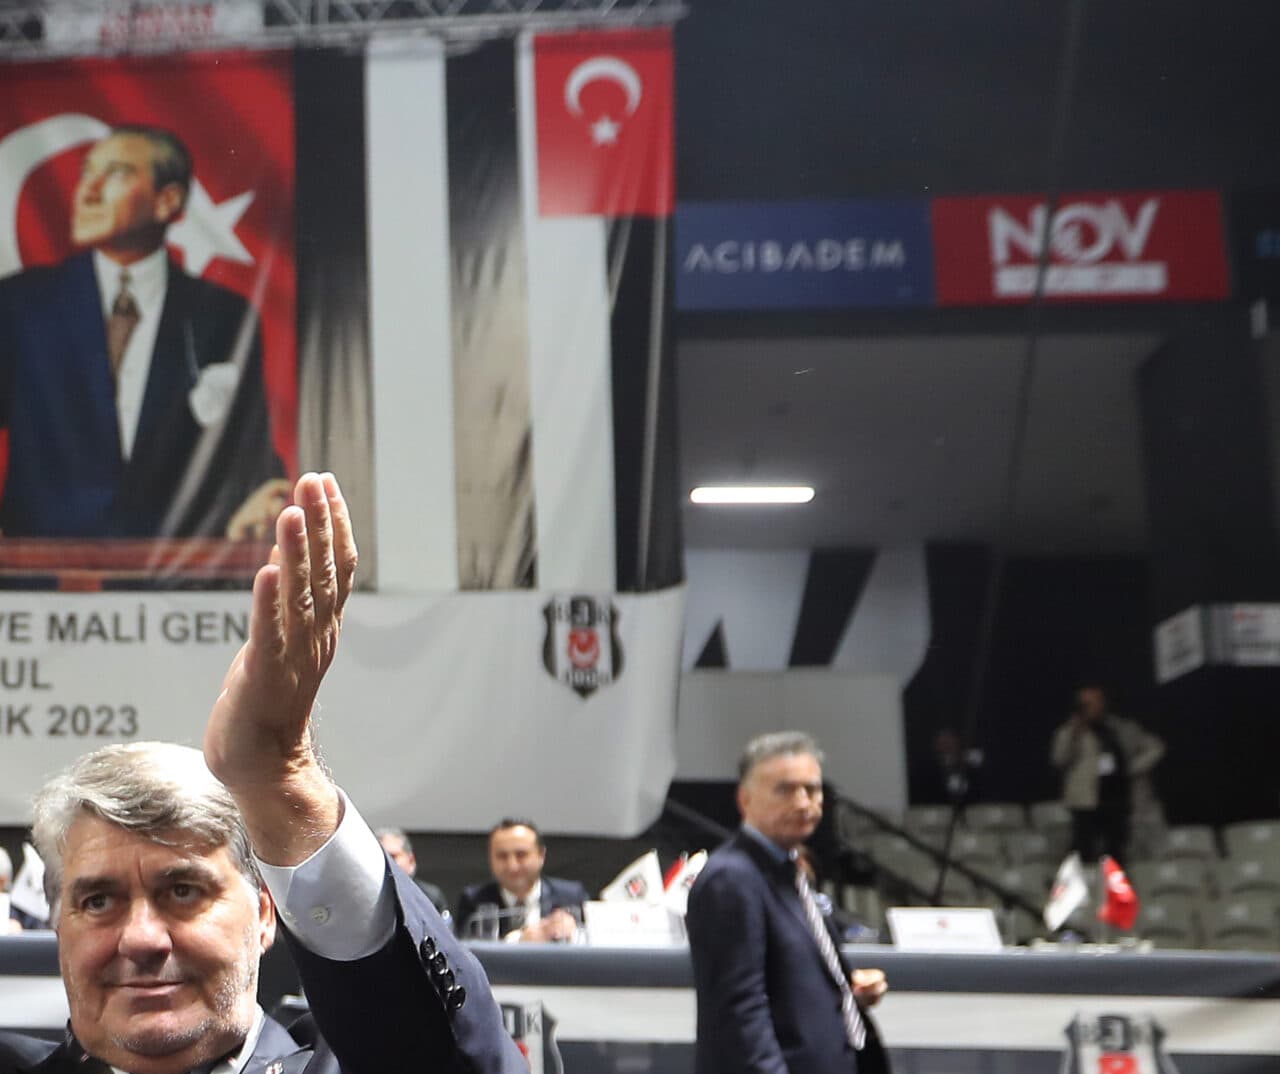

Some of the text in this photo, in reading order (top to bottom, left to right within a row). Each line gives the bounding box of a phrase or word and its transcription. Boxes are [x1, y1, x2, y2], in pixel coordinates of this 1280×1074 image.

[683, 237, 907, 274] ACIBADEM
[46, 603, 148, 643] MALİ
[161, 610, 250, 643] GEN
[46, 705, 140, 737] 2023
